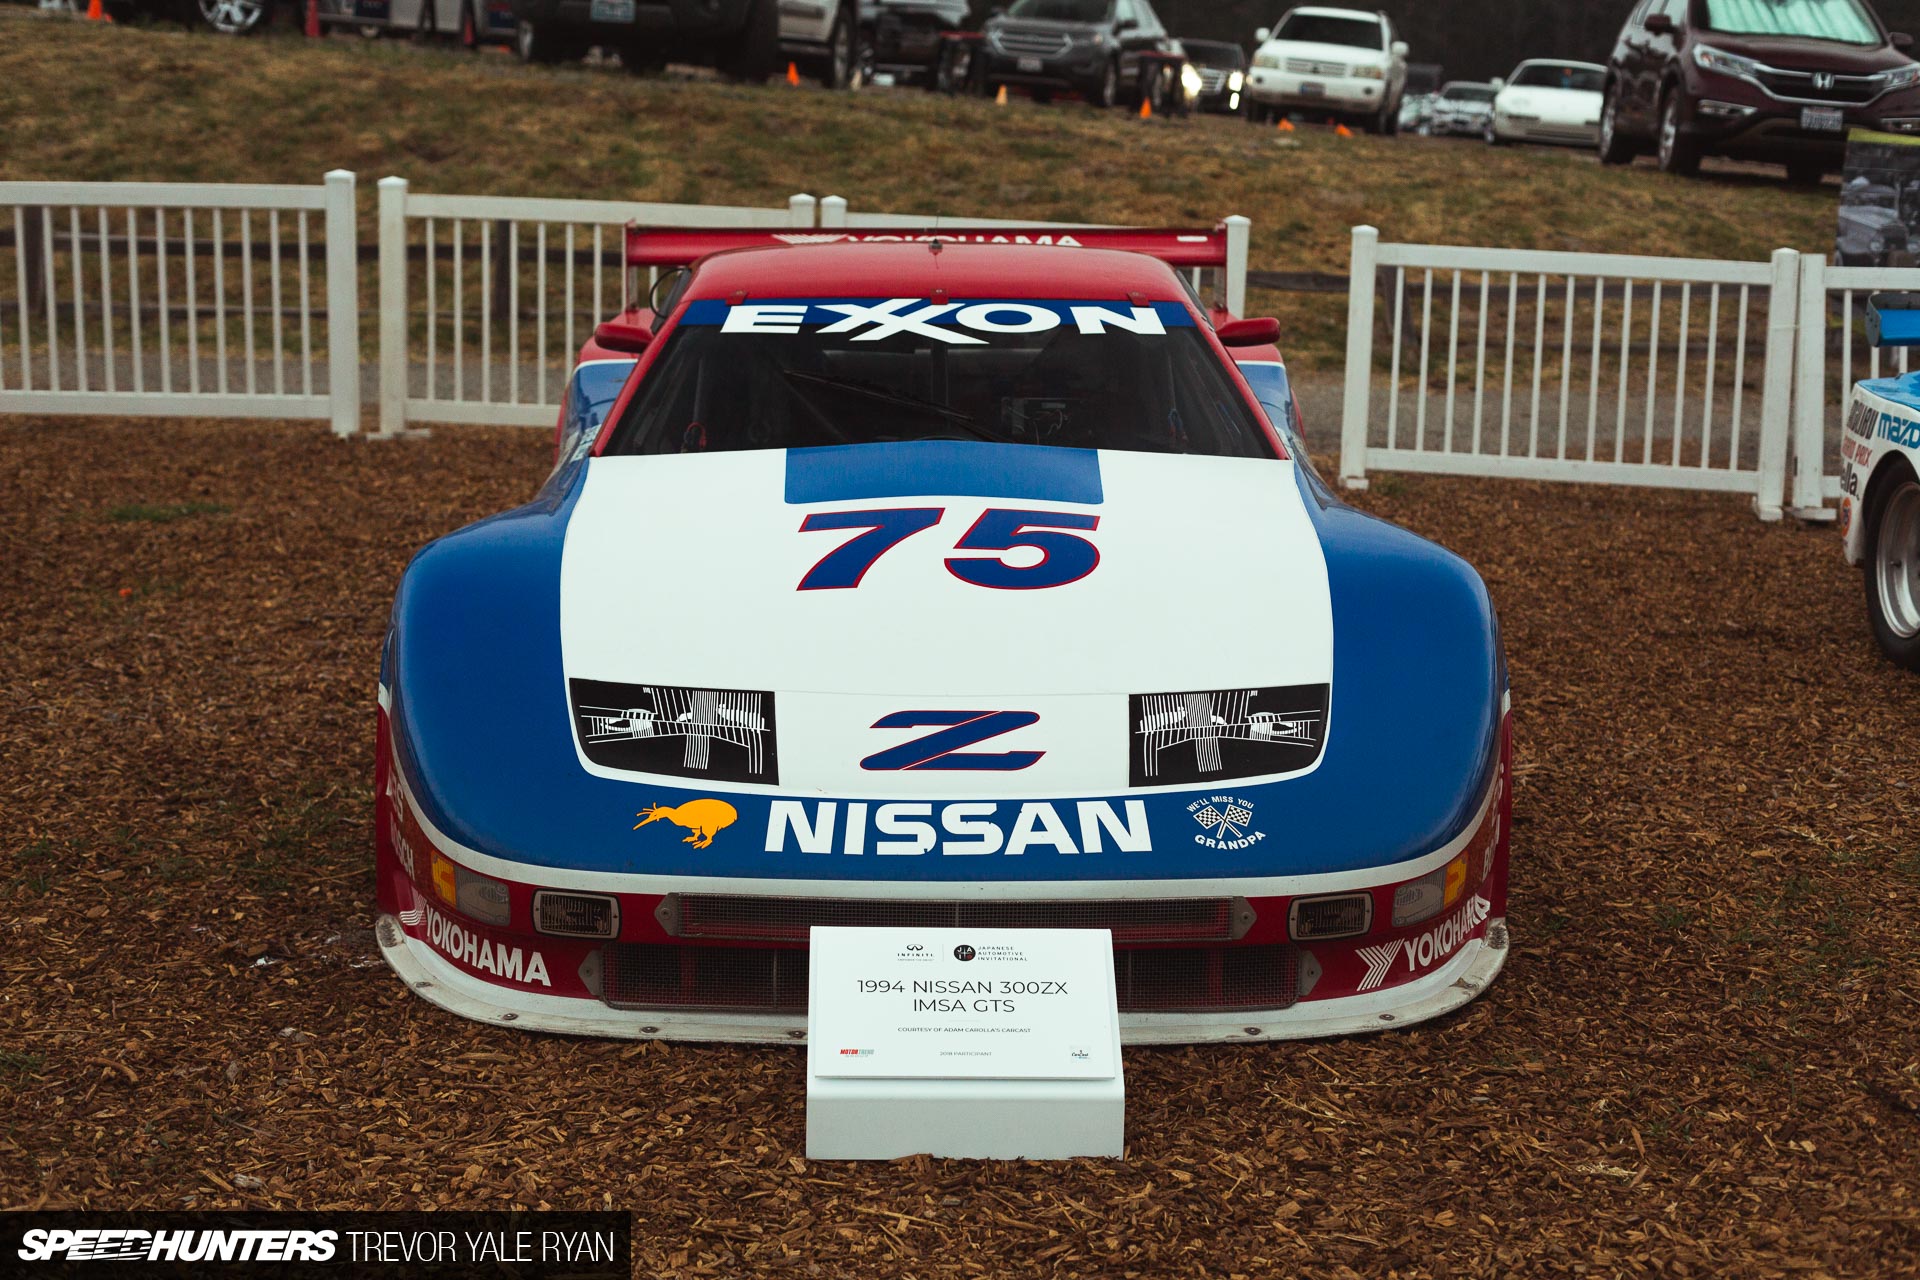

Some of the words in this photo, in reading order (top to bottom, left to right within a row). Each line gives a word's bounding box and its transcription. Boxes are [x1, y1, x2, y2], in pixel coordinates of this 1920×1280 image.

[720, 298, 1167, 344] EXXON
[796, 507, 1101, 591] 75
[859, 710, 1047, 771] Z
[1186, 797, 1210, 812] WE'LL
[1211, 795, 1234, 803] MISS
[1237, 798, 1255, 809] YOU
[764, 799, 1153, 856] NISSAN
[1194, 831, 1267, 850] GRANDPA
[425, 904, 552, 987] YOKOHAMA
[857, 980, 906, 993] 1994
[913, 980, 992, 994] NISSAN
[999, 981, 1069, 995] 300ZX
[913, 998, 967, 1012] IMSA
[973, 999, 1015, 1013] GTS
